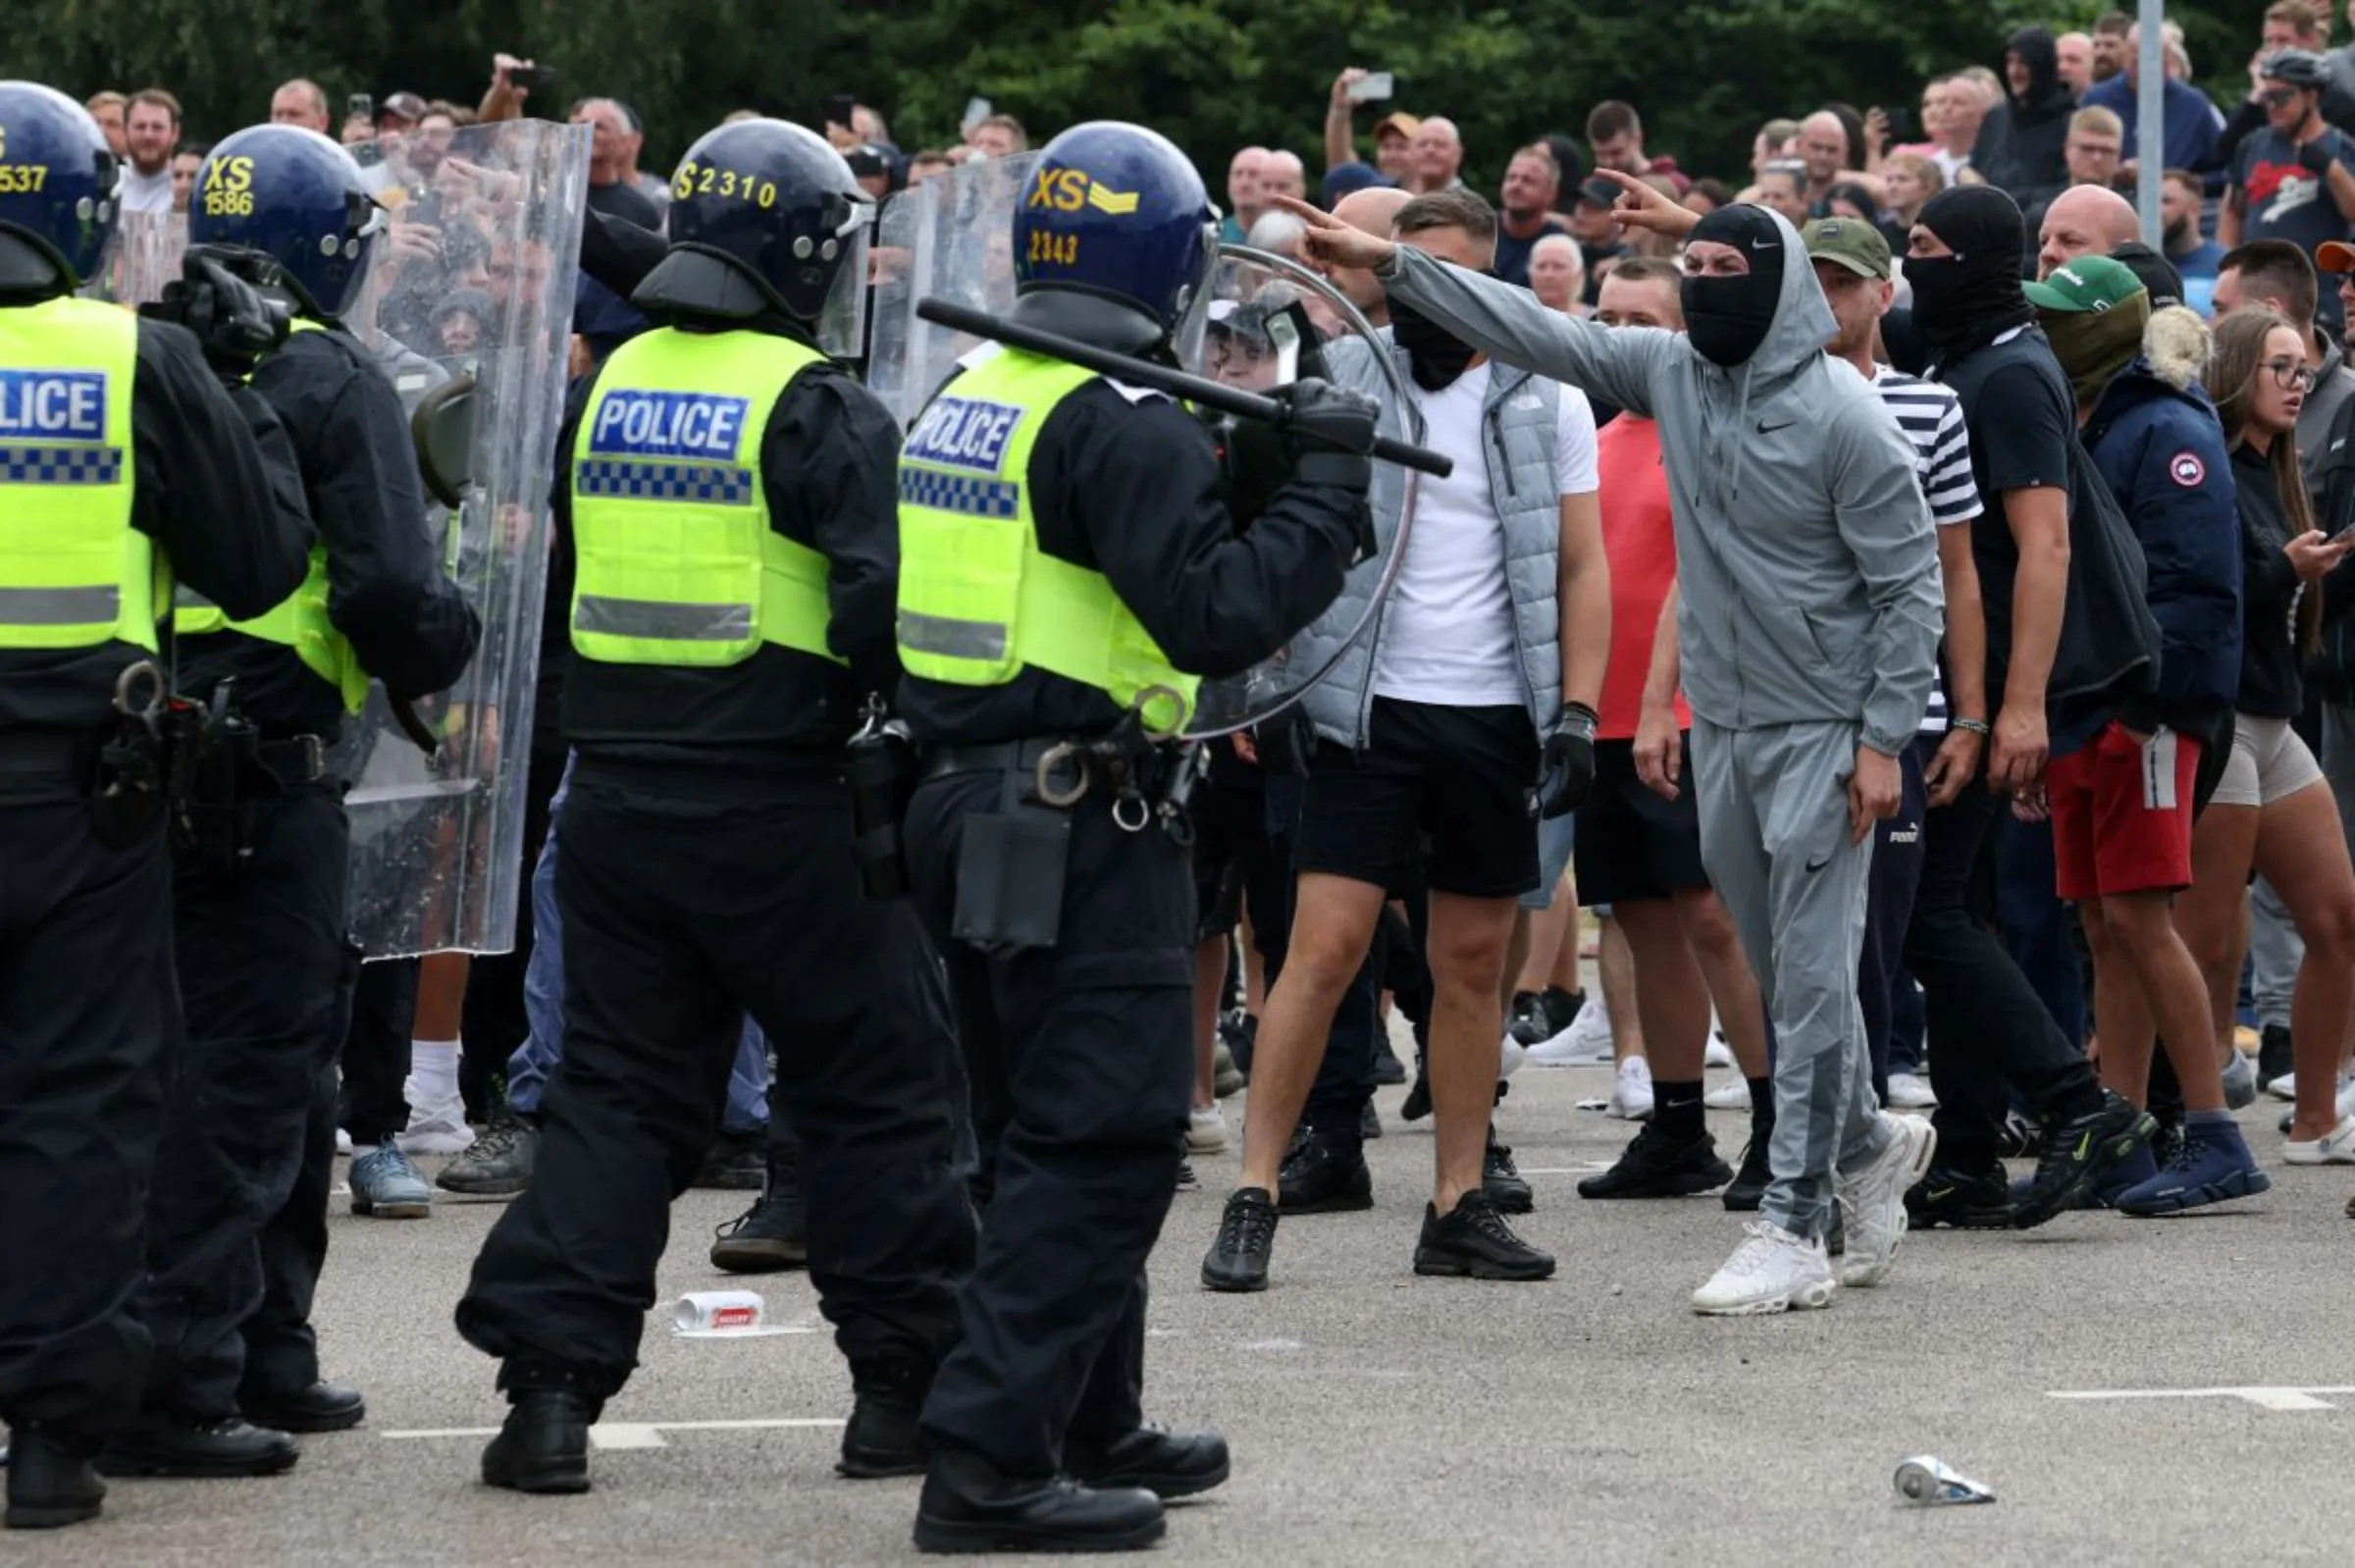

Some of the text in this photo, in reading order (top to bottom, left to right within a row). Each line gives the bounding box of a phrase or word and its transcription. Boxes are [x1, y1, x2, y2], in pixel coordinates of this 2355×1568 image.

[204, 156, 254, 190] XS
[1029, 168, 1088, 210] XS
[204, 190, 253, 215] 1586
[1028, 230, 1078, 265] 2343
[0, 380, 97, 431] LICE
[596, 397, 742, 450] POLICE
[909, 403, 1012, 462] POLICE
